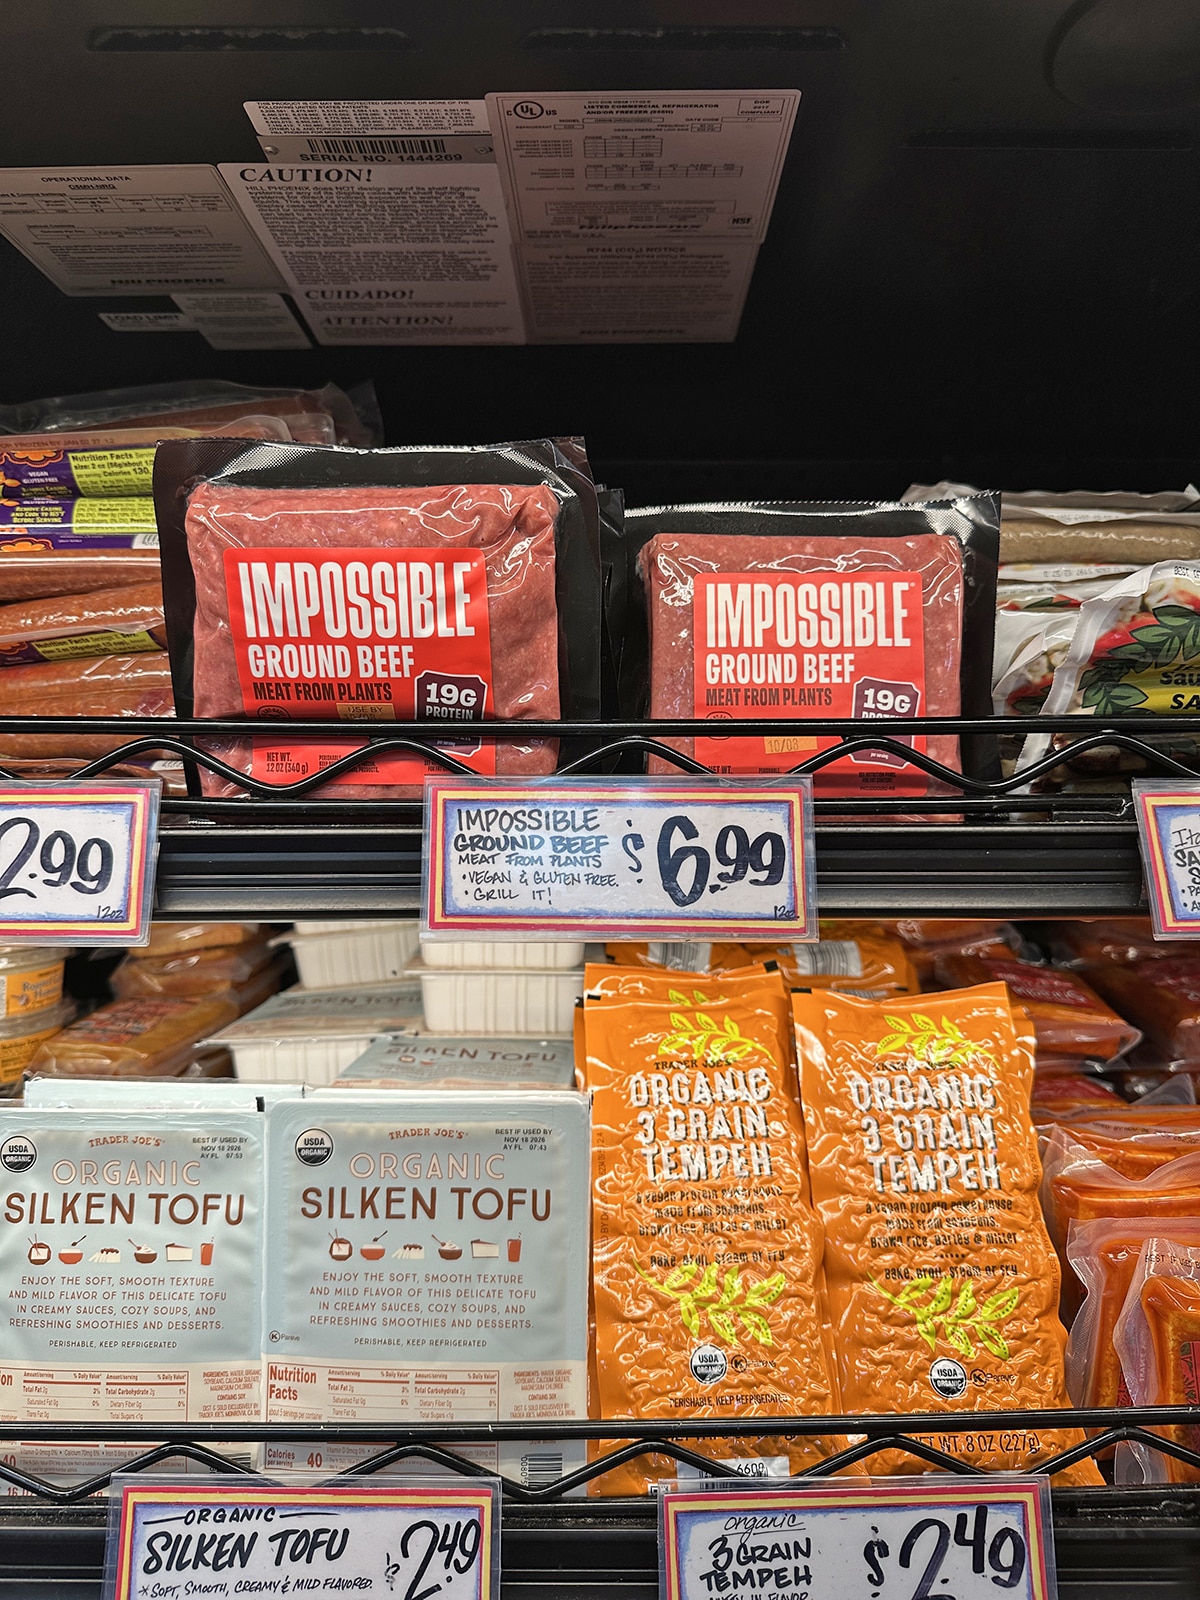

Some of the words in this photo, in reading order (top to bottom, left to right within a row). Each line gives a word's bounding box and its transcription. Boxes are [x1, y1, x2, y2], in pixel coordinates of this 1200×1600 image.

[364, 154, 390, 162] NO.
[240, 169, 372, 182] CAUTION!
[305, 290, 414, 299] CUIDADO!
[321, 317, 453, 325] ATTENTION!
[238, 562, 475, 638] IMPOSSIBLE
[706, 582, 911, 648] IMPOSSIBLE
[248, 644, 352, 678] GROUND
[358, 644, 414, 678] BEEF
[706, 654, 797, 684] GROUND
[804, 653, 854, 684] BEEF
[253, 682, 292, 701] MEAT
[296, 683, 334, 701] FROM
[338, 682, 392, 701] PLANTS
[426, 682, 477, 706] 19G
[706, 688, 740, 706] MEAT
[744, 688, 780, 706] FROM
[782, 688, 832, 706] PLANTS
[864, 688, 911, 712] 19G
[426, 706, 473, 720] PROTEIN
[266, 752, 280, 762] NET
[281, 752, 292, 762] WT.
[266, 762, 274, 772] 12
[276, 762, 284, 772] OZ
[457, 809, 601, 832] IMPOSSIBLE
[454, 835, 544, 852] GROUND
[550, 836, 609, 851] BEEF
[458, 853, 496, 866] MEAT
[505, 855, 544, 866] FROM
[551, 855, 602, 867] PLANTS
[469, 872, 511, 884] VEGAN
[534, 871, 581, 885] GLUTEN
[584, 873, 619, 888] FREE.
[474, 888, 519, 901] GRILL
[532, 888, 552, 905] IT!
[654, 1060, 698, 1071] TRADER
[630, 1068, 770, 1107] ORGANIC
[849, 1074, 996, 1111] ORGANIC
[634, 1109, 656, 1144] 3
[668, 1105, 770, 1141] GRAIN
[89, 1136, 129, 1147] TRADER
[132, 1136, 162, 1146] JOE'S
[304, 1138, 325, 1146] USDA
[389, 1129, 430, 1140] TRADER
[434, 1128, 465, 1139] JOE'S
[861, 1115, 882, 1153] 3
[893, 1114, 998, 1150] GRAIN
[9, 1145, 28, 1153] USDA
[349, 1153, 505, 1180] ORGANIC
[641, 1144, 773, 1182] TEMPEH
[52, 1160, 200, 1186] ORGANIC
[868, 1153, 1001, 1193] TEMPEH
[4, 1192, 135, 1225] SILKEN
[148, 1193, 244, 1225] TOFU
[301, 1187, 436, 1219] SILKEN
[451, 1188, 551, 1221] TOFU
[323, 1273, 359, 1282] ENJOY
[364, 1273, 384, 1282] THE
[389, 1273, 419, 1284] SOFT,
[424, 1273, 471, 1283] SMOOTH
[477, 1274, 523, 1284] TEXTURE
[310, 1316, 377, 1326] REFRESHING
[382, 1317, 446, 1327] SMOOTHIES
[451, 1318, 471, 1327] AND
[477, 1318, 534, 1328] DESSERTS.
[49, 1340, 96, 1348] PERISHABLE,
[698, 1354, 719, 1363] USDA
[270, 1366, 317, 1384] Nutrition
[937, 1368, 958, 1378] USDA
[270, 1384, 298, 1401] Facts
[328, 1384, 341, 1392] Total
[433, 1387, 459, 1395] Carbohydrate
[940, 1436, 962, 1452] WT.
[966, 1436, 974, 1452] 8
[978, 1436, 996, 1452] OZ
[267, 1449, 295, 1460] Calories
[307, 1452, 323, 1468] 40
[184, 1508, 276, 1524] ORGANIC
[724, 1512, 805, 1545] organic
[144, 1530, 259, 1574] SILKEN
[268, 1528, 349, 1566] TOFU
[736, 1536, 812, 1565] GRAIN
[185, 1582, 229, 1597] SMOOTH,
[234, 1580, 280, 1594] CREAMY
[293, 1578, 321, 1591] MILD
[323, 1576, 372, 1590] FLAVORED.
[700, 1565, 812, 1592] TEMPEH
